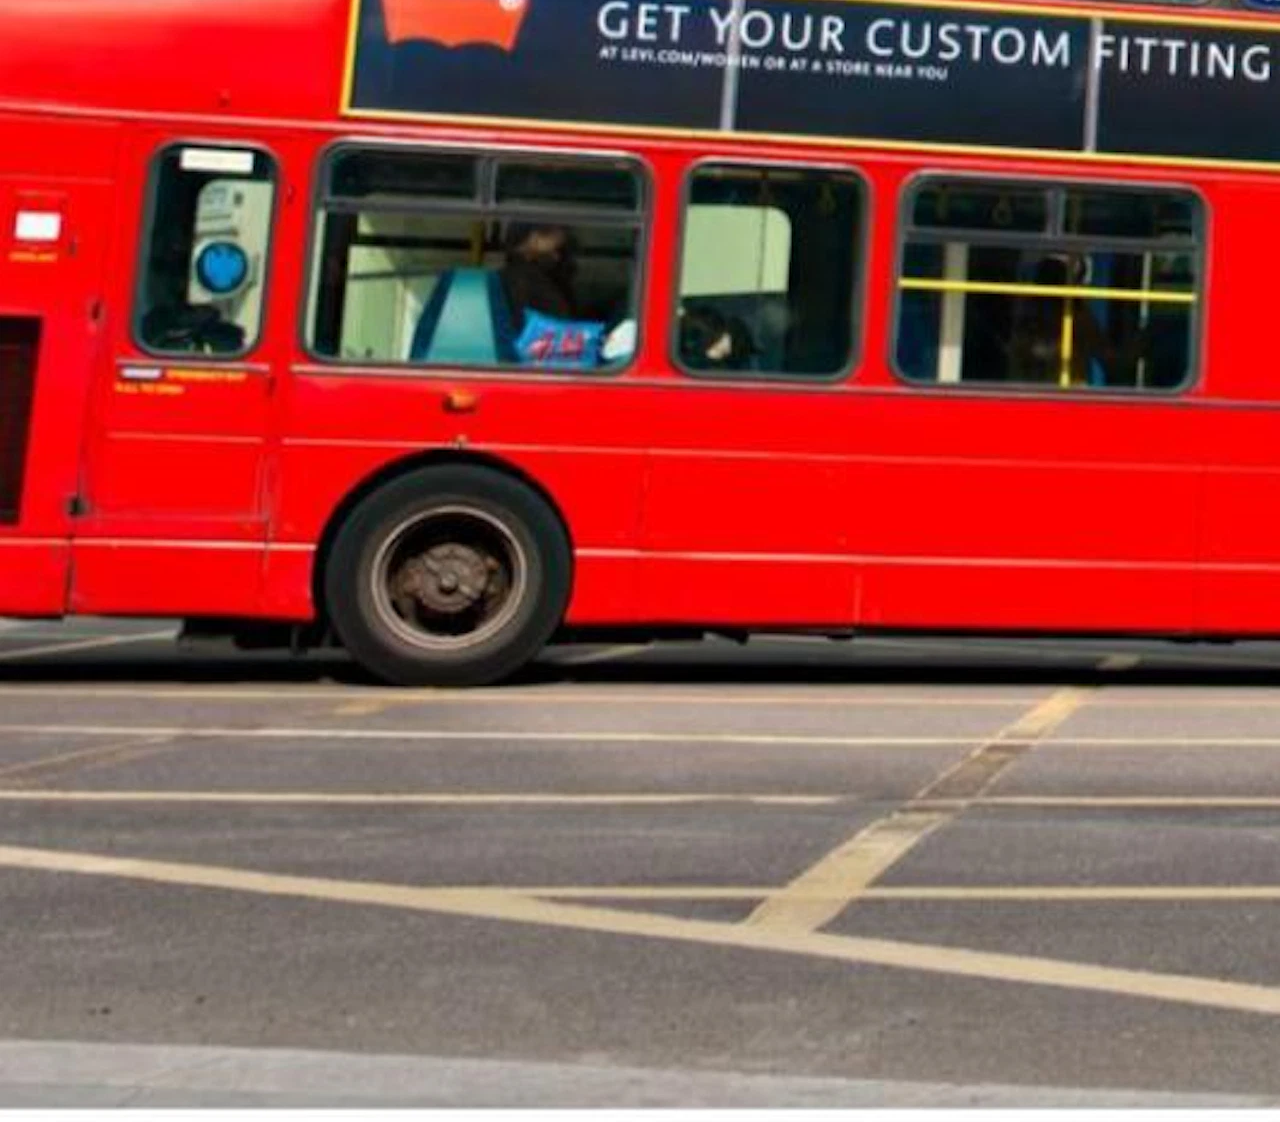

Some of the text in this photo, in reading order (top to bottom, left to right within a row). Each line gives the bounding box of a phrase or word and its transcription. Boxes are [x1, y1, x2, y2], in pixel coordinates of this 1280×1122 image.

[597, 1, 690, 42] GET
[709, 7, 845, 54] YOUR
[866, 17, 1070, 68] CUSTOM
[1096, 34, 1271, 82] FITTING
[600, 46, 618, 60] AT
[763, 56, 786, 72] OR
[789, 57, 808, 72] AT
[811, 59, 823, 72] A
[826, 59, 870, 77] STORE
[875, 63, 912, 78] NEAR
[916, 65, 949, 80] YOU
